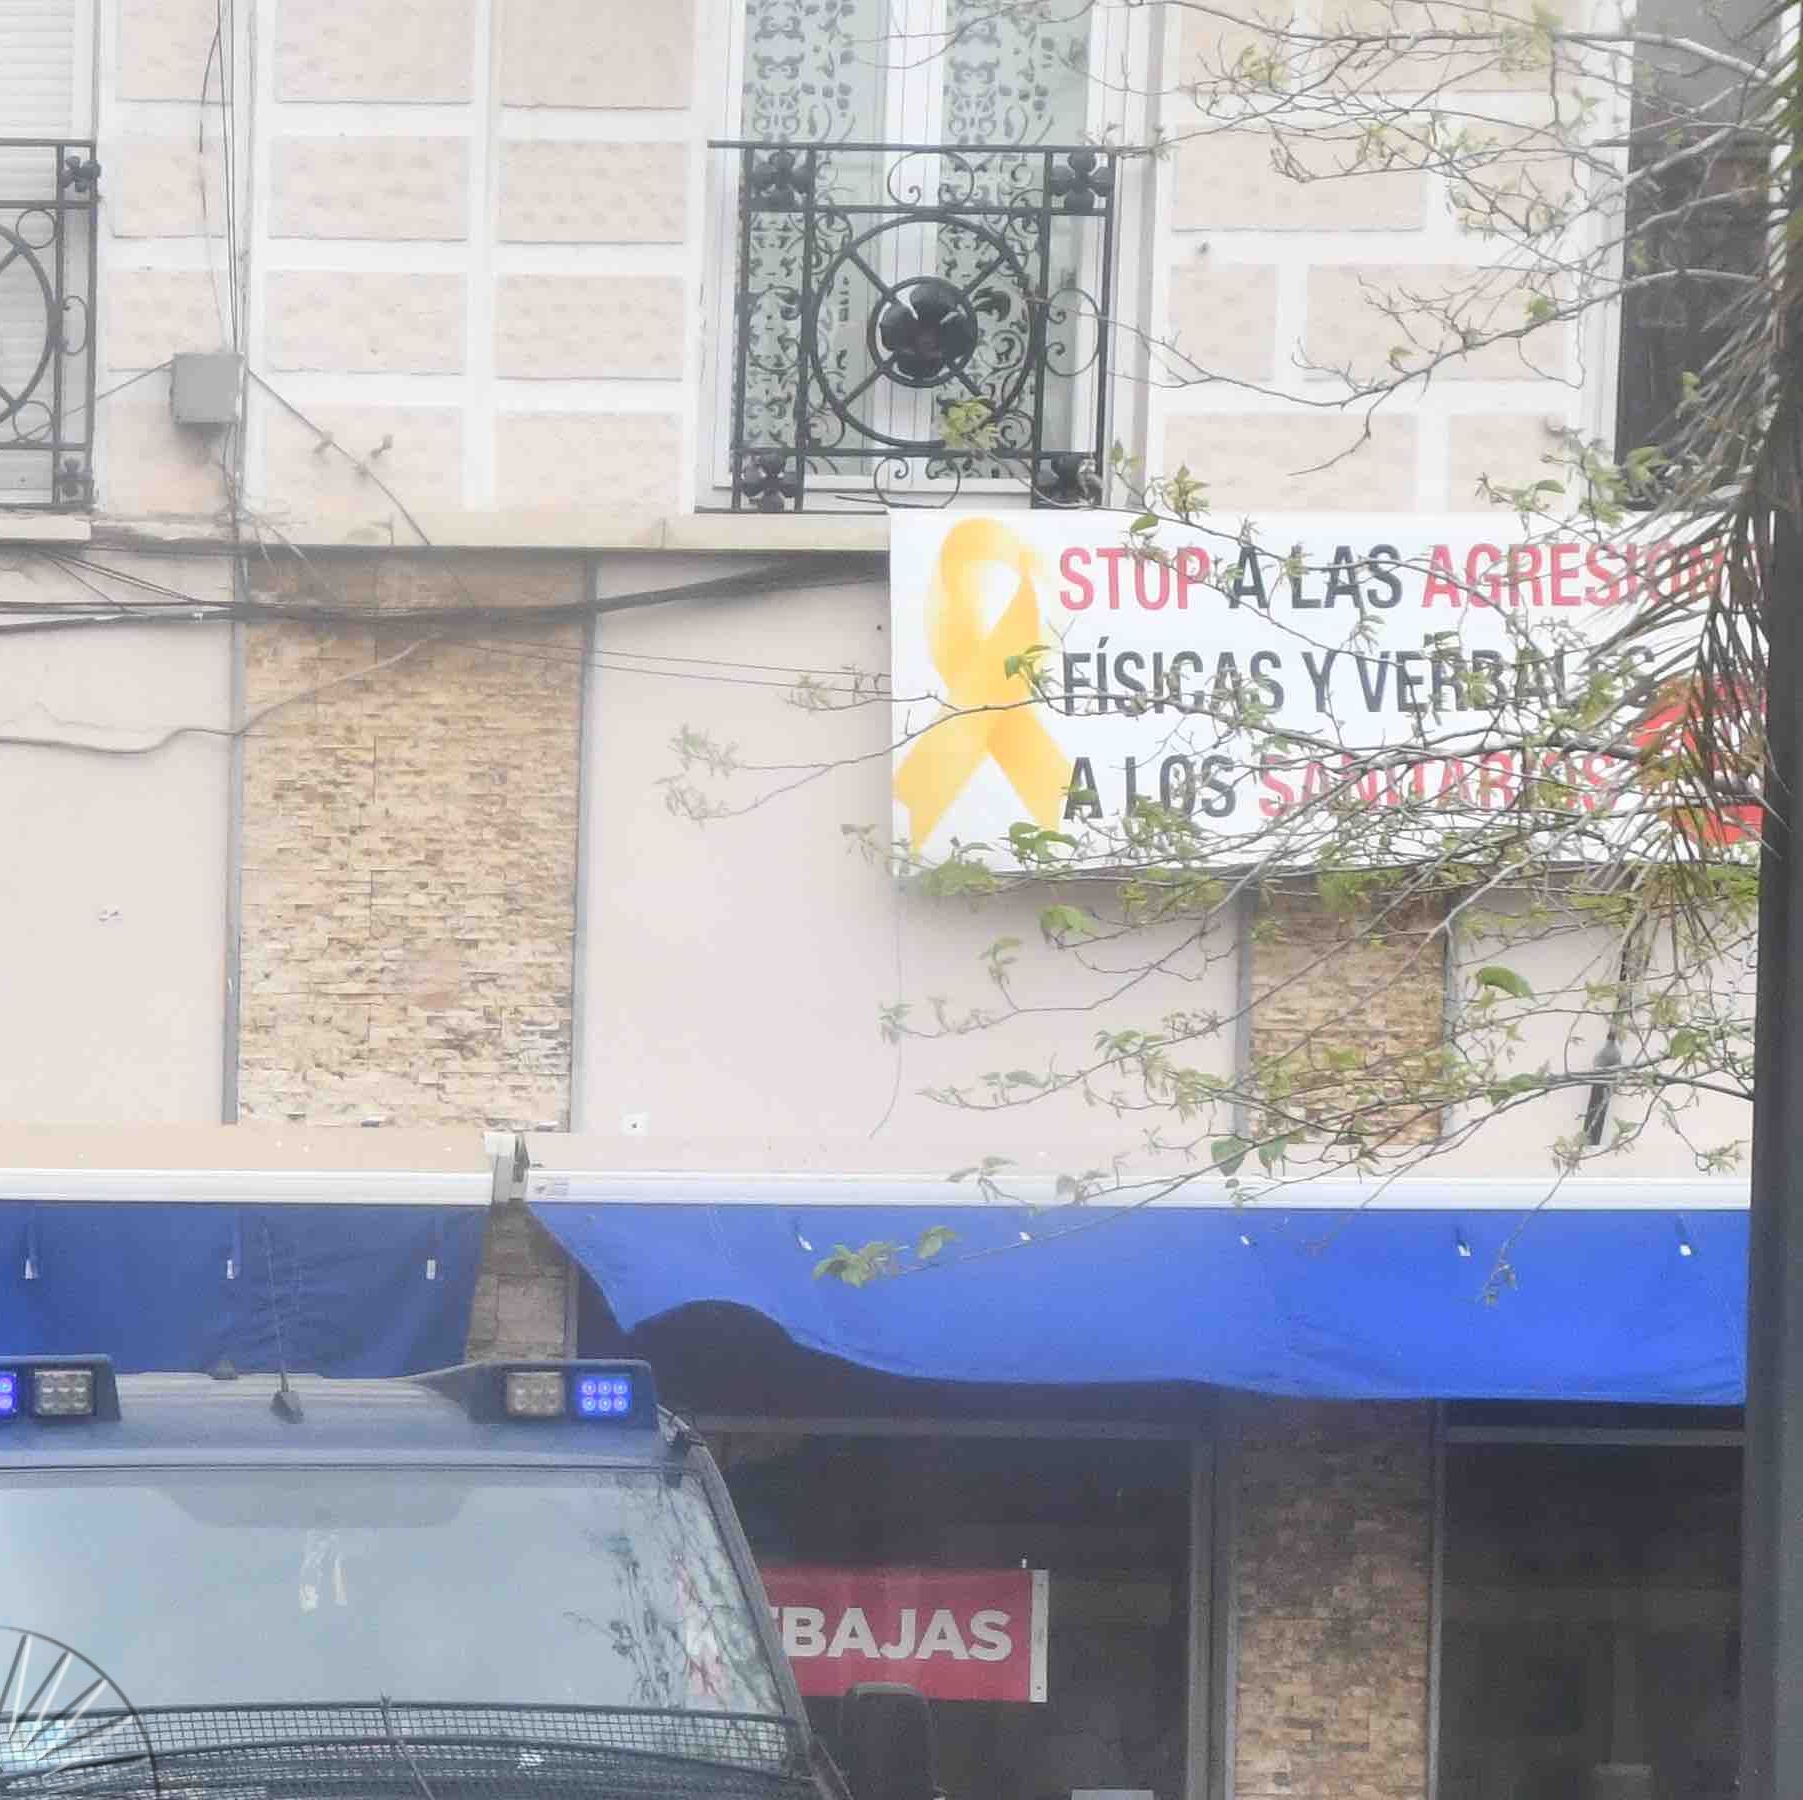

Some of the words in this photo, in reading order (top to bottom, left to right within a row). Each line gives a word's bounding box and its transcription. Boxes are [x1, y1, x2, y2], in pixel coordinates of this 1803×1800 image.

[1059, 546, 1210, 610] STOP
[1228, 545, 1270, 609] A
[1290, 544, 1402, 609] LAS
[1063, 636, 1284, 716] FÍSICAS
[1301, 650, 1339, 712] Y
[1062, 756, 1103, 820] A
[771, 1605, 1013, 1663] BAJAS
